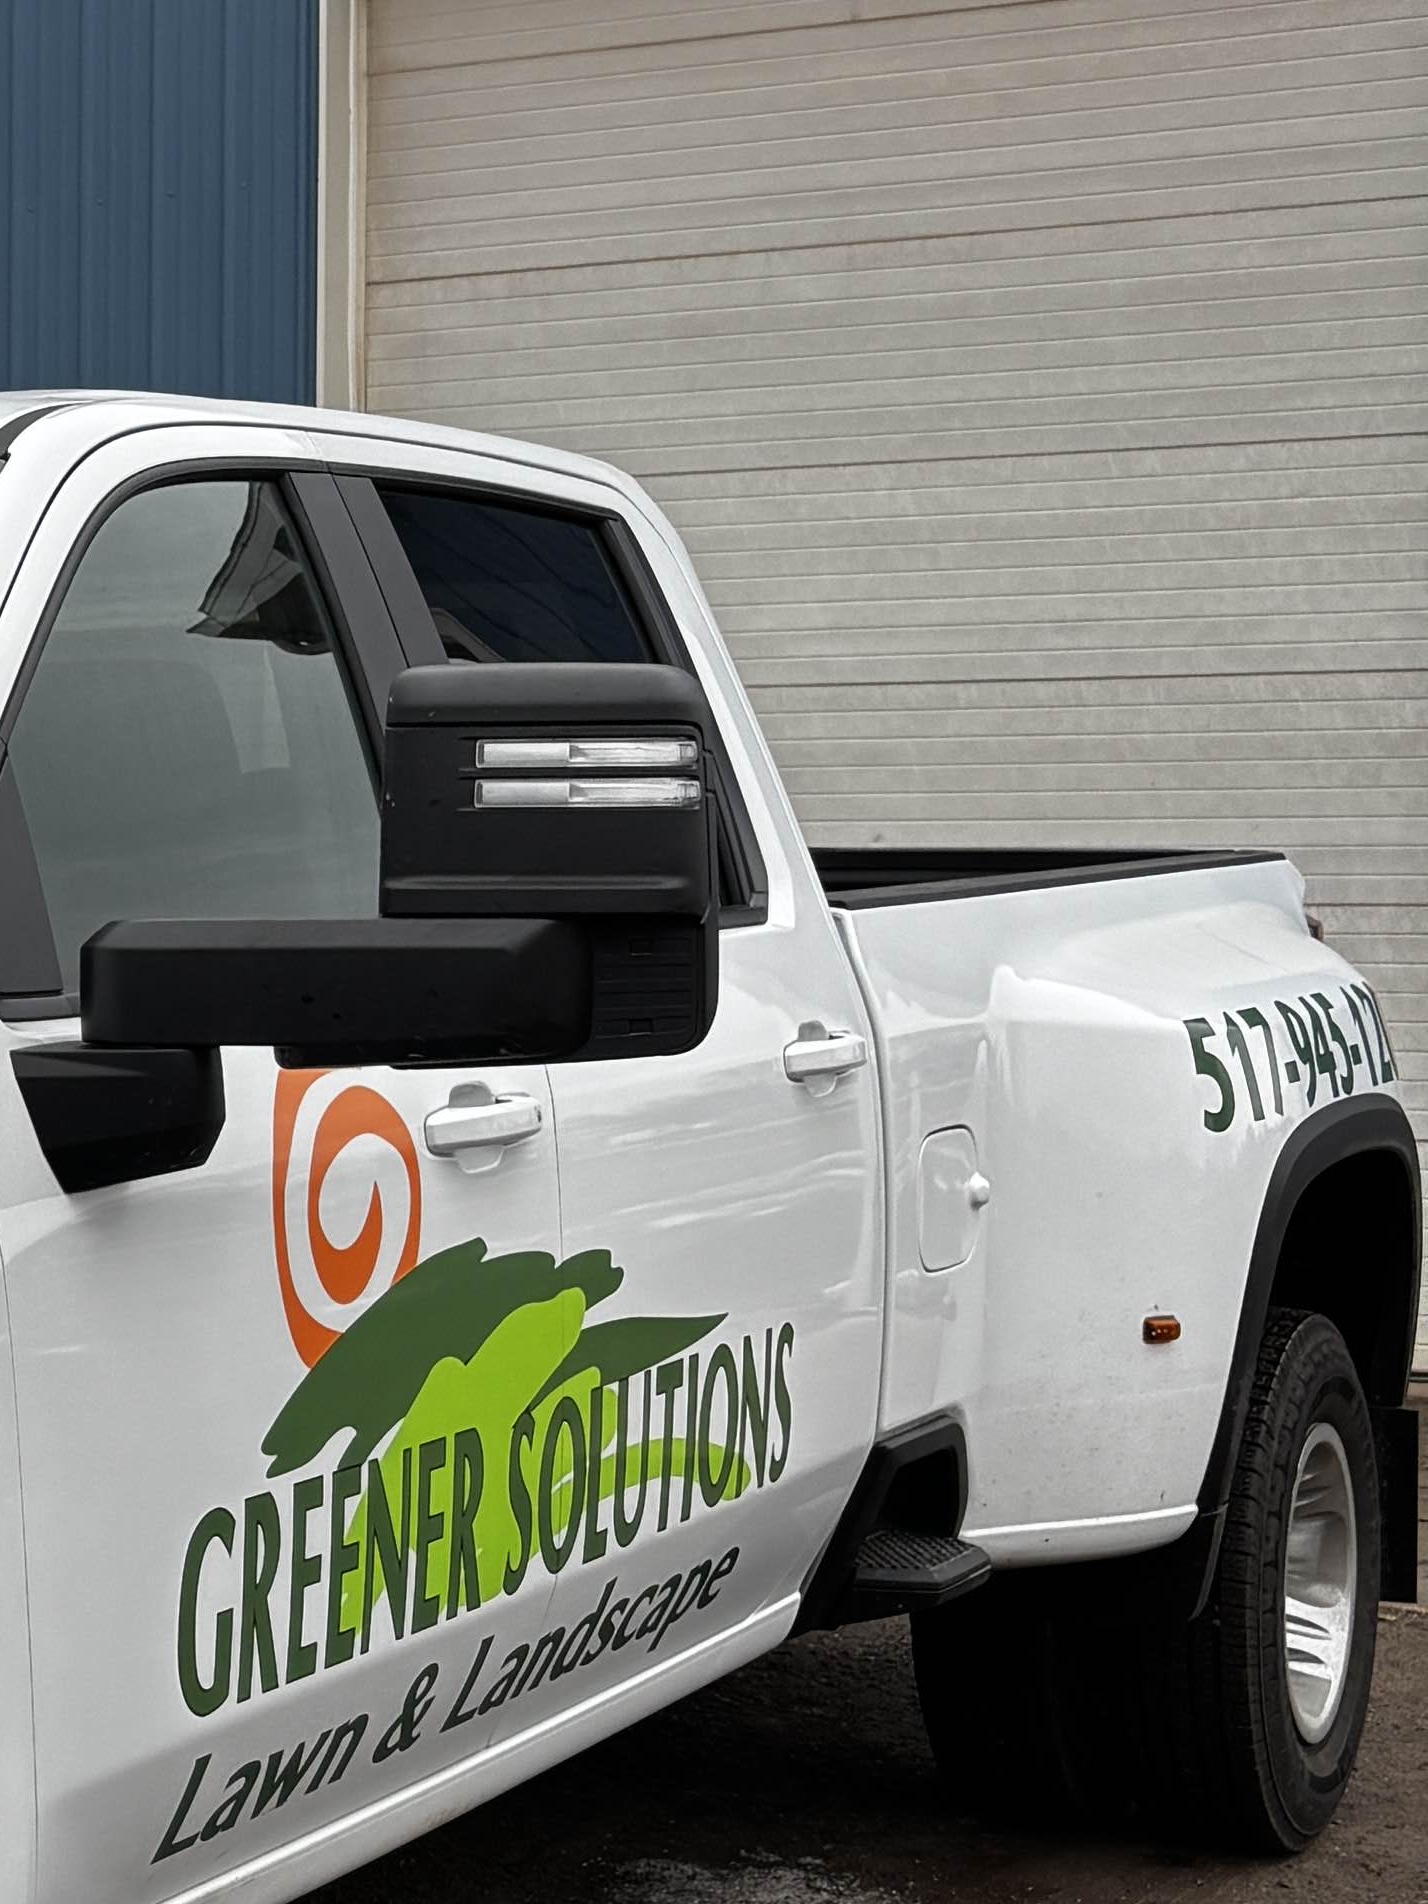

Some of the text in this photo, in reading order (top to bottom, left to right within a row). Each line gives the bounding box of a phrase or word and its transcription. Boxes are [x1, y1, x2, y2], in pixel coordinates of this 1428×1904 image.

[1182, 981, 1399, 1133] 517-945-12
[177, 1322, 794, 1717] GREENER SOLUTIONS
[150, 1547, 740, 1865] Lawn & Landscape
